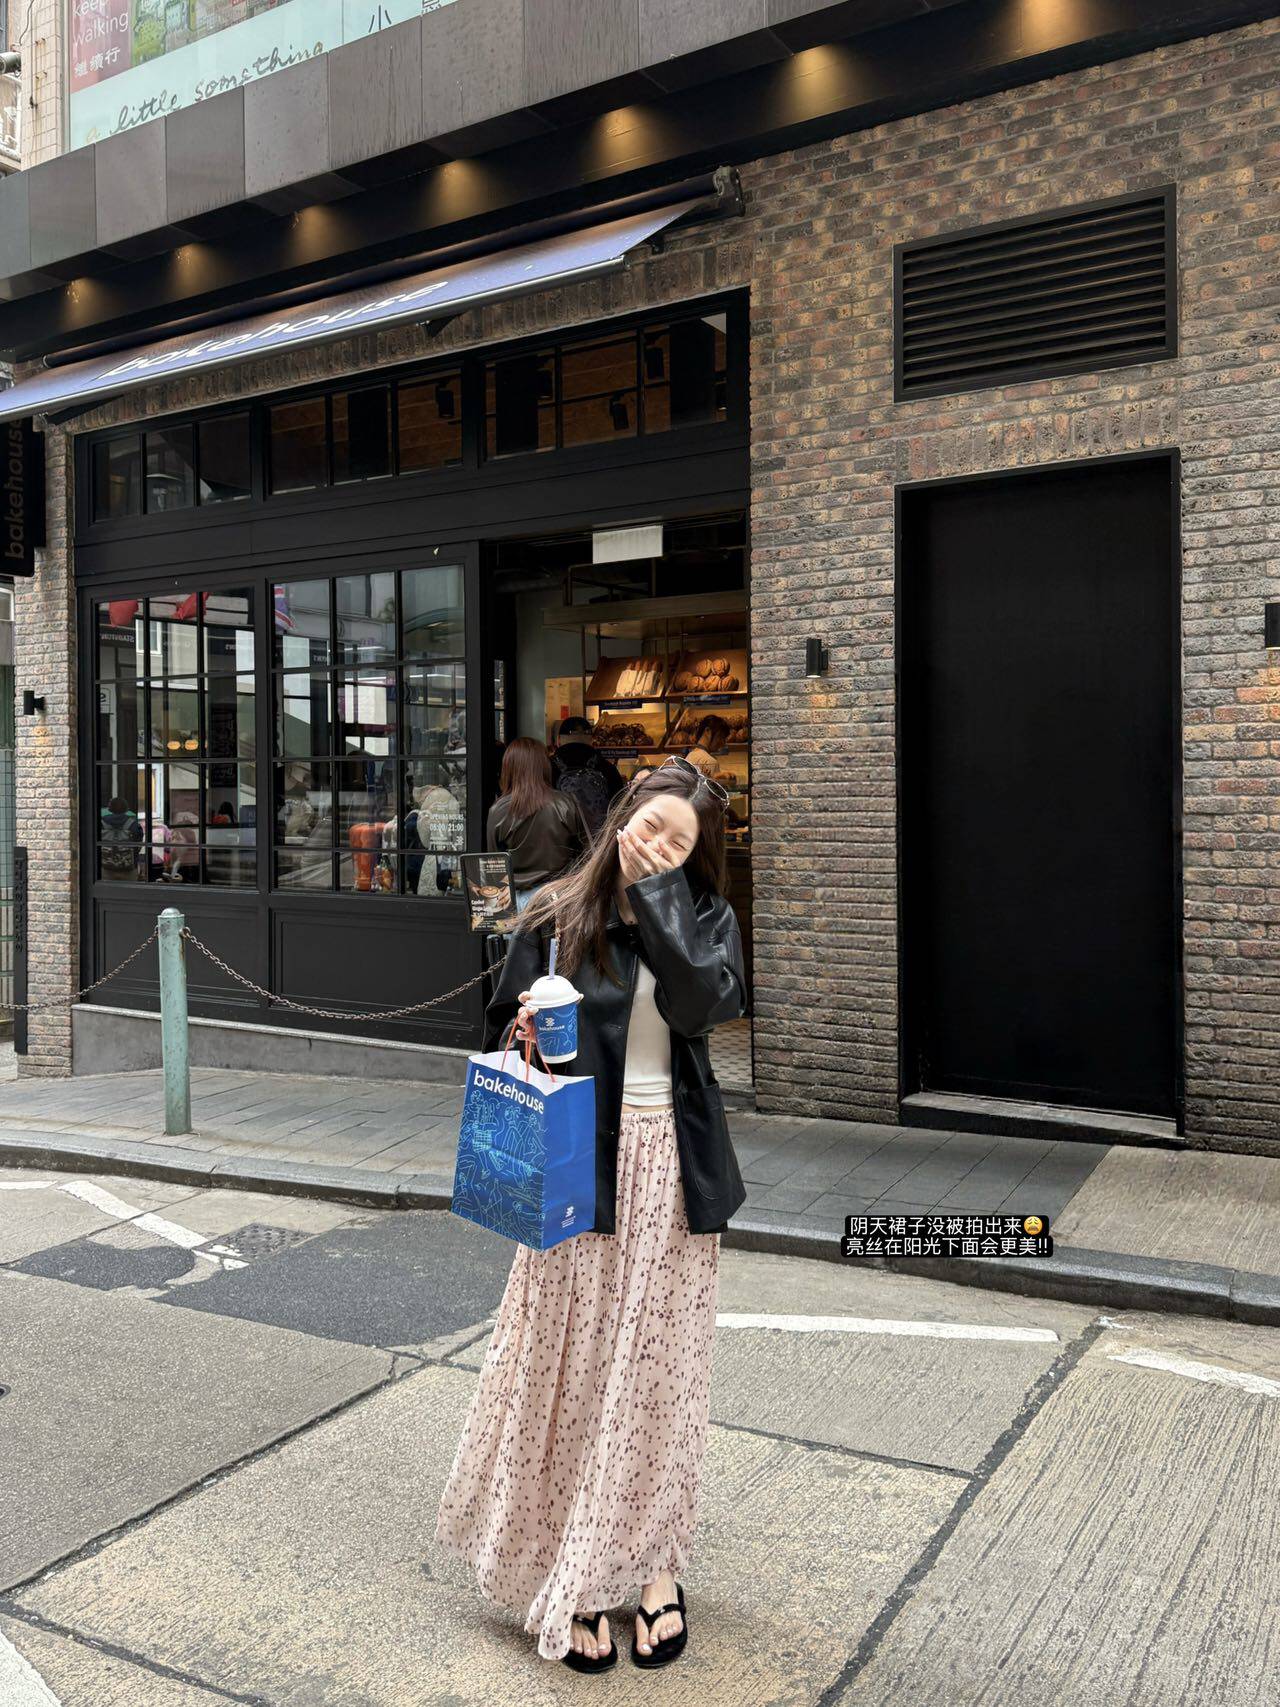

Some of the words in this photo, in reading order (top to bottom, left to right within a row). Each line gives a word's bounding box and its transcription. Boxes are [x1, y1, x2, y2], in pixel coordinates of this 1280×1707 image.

[73, 12, 129, 47] walking
[74, 47, 121, 78] 繼續行
[110, 89, 181, 134] little
[92, 281, 449, 381] bakehouse
[473, 1069, 545, 1115] bakehouse
